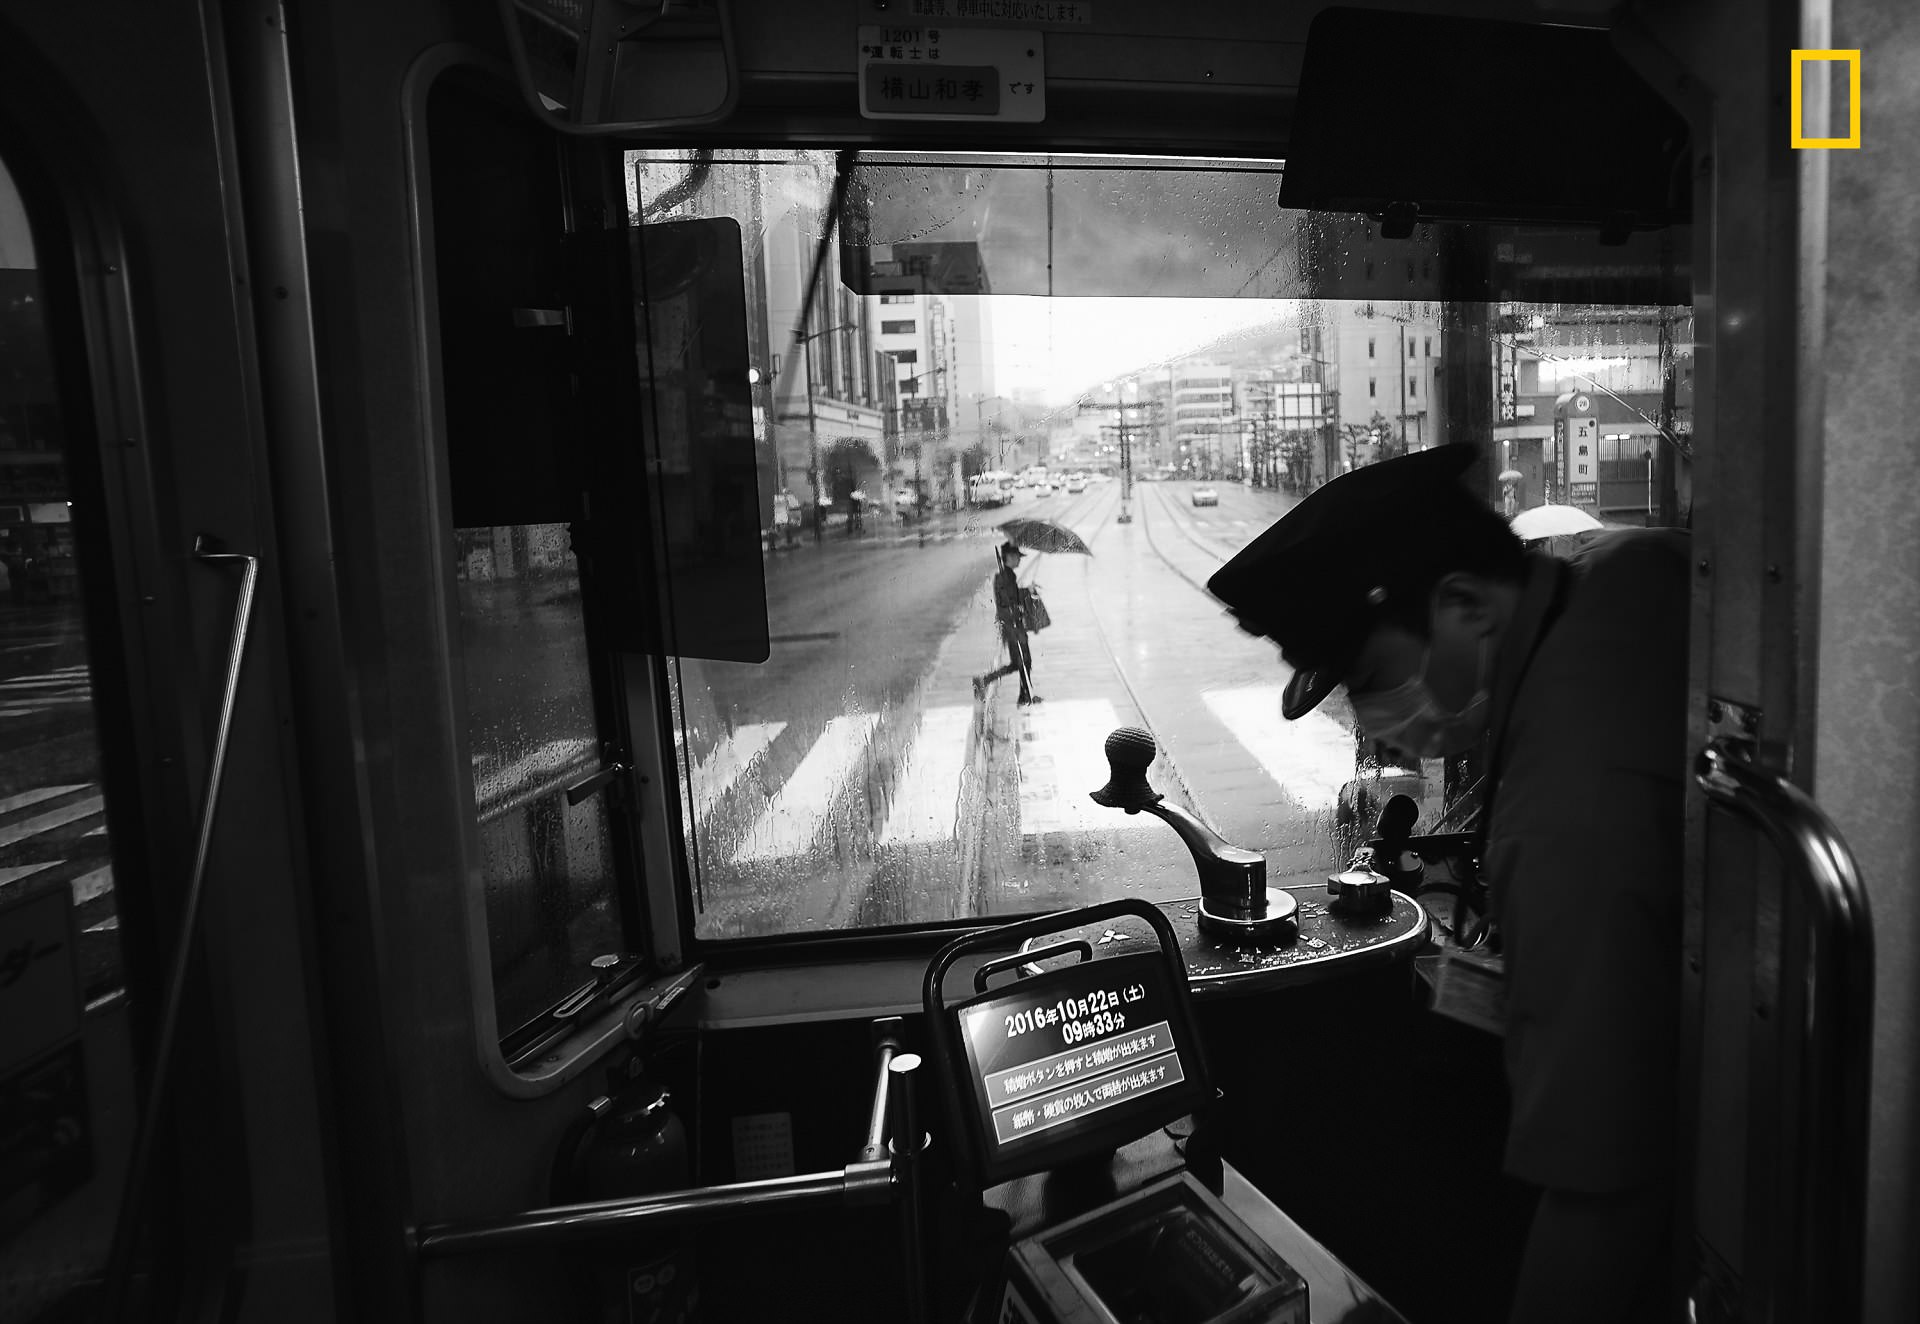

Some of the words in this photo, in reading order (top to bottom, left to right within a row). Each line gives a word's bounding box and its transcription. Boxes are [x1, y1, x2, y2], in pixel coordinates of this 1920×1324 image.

[870, 45, 940, 59] 運転士は
[881, 76, 985, 101] 横山和孝
[1008, 82, 1036, 95] です
[1062, 1010, 1126, 1044] 09時33分
